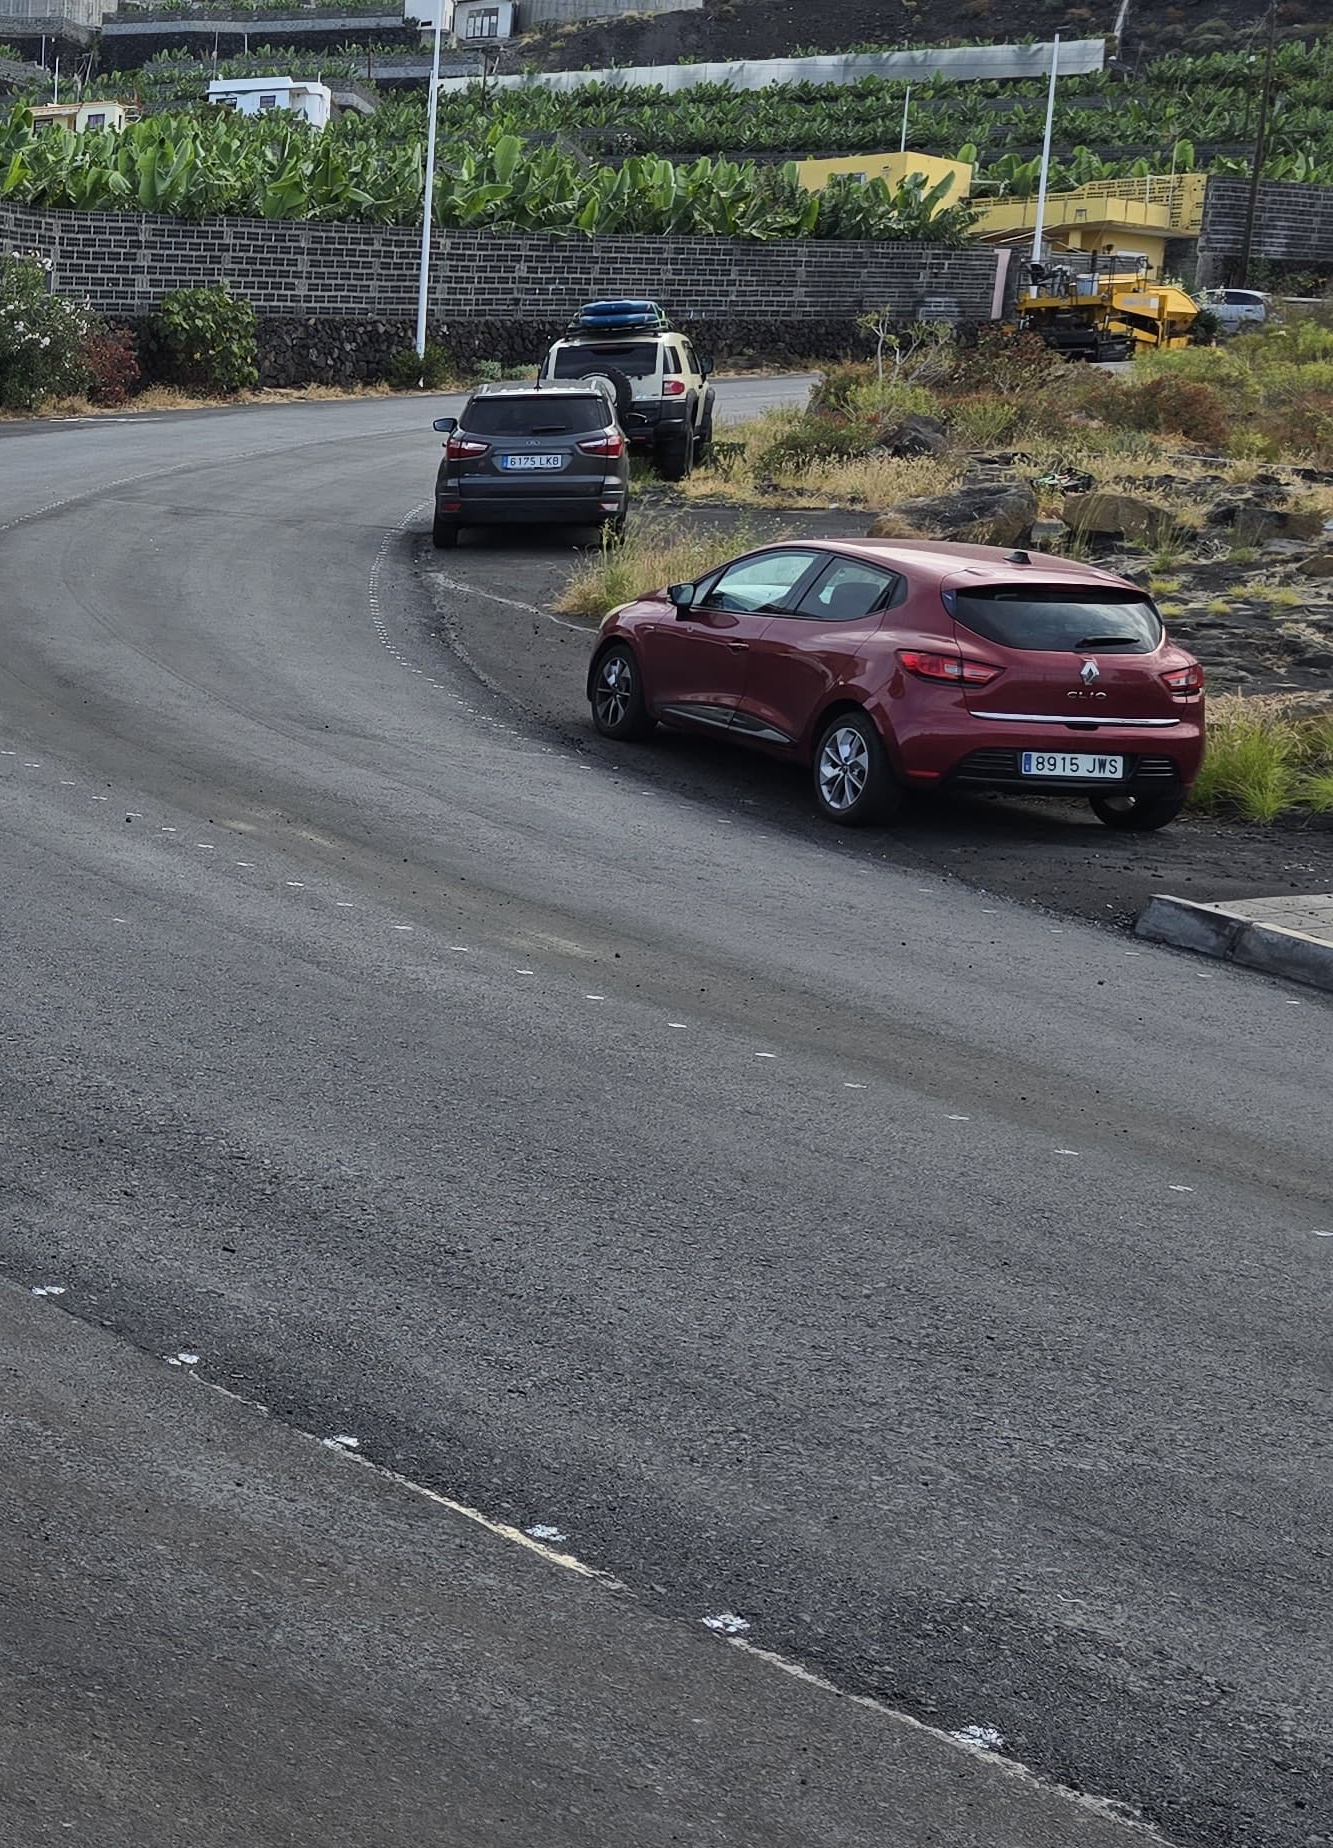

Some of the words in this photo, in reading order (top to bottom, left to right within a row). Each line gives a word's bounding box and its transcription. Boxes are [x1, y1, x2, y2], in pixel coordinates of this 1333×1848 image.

[510, 457, 536, 466] 6175
[1035, 755, 1080, 773] 8915
[1086, 758, 1118, 775] JWS
